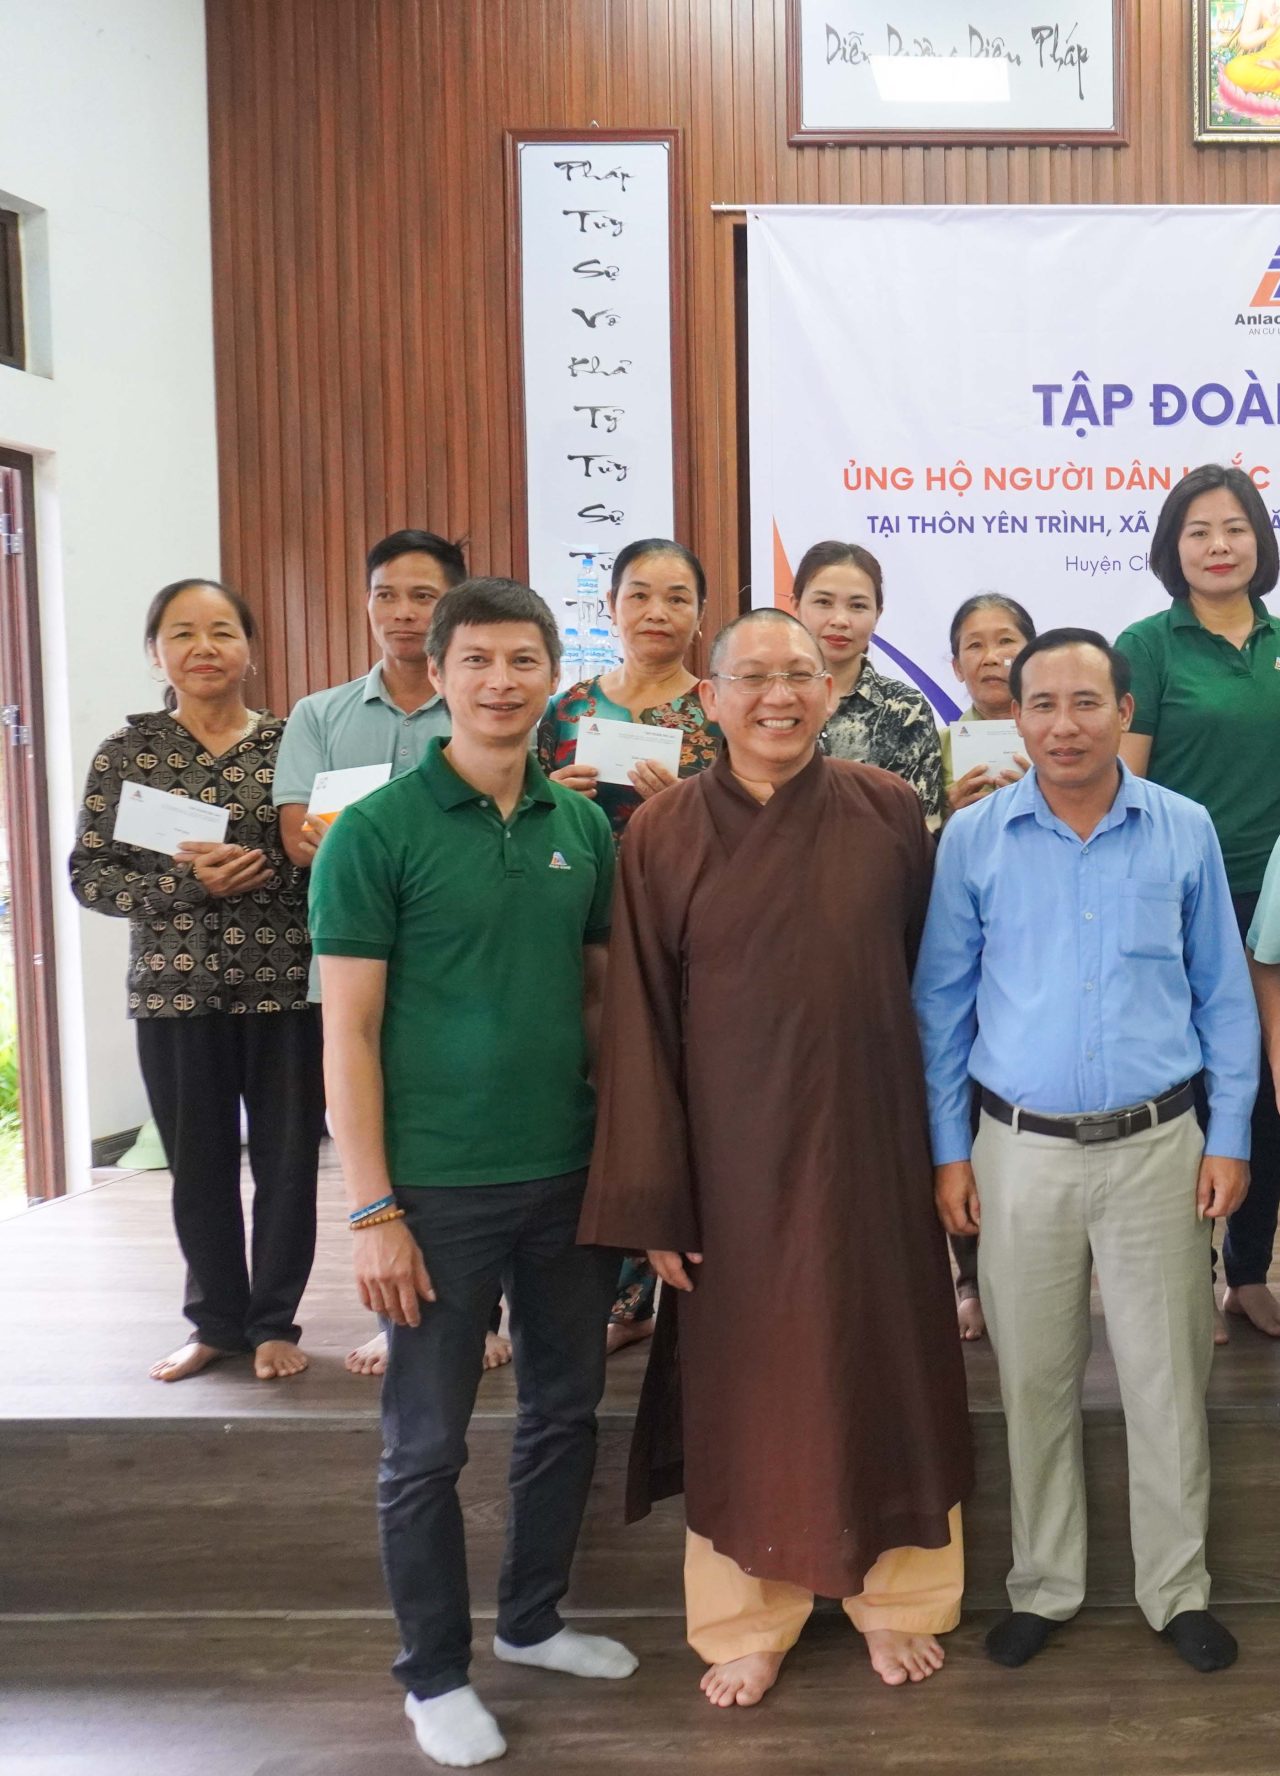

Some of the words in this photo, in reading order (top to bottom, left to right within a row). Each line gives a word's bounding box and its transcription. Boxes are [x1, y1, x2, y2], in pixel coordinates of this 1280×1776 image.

[1031, 22, 1090, 100] Pháp
[1032, 370, 1134, 438] TẬP
[844, 459, 915, 491] ỦNG
[926, 459, 973, 497] HỘ
[984, 461, 1093, 491] NGƯỜI
[1105, 459, 1171, 491] DÂN
[867, 515, 900, 538] TẠI
[907, 510, 975, 534] THÔN
[982, 510, 1028, 534] YÊN
[1035, 510, 1112, 537] TRÌNH,
[1119, 510, 1150, 533] XÃ
[1065, 555, 1121, 577] Huyện
